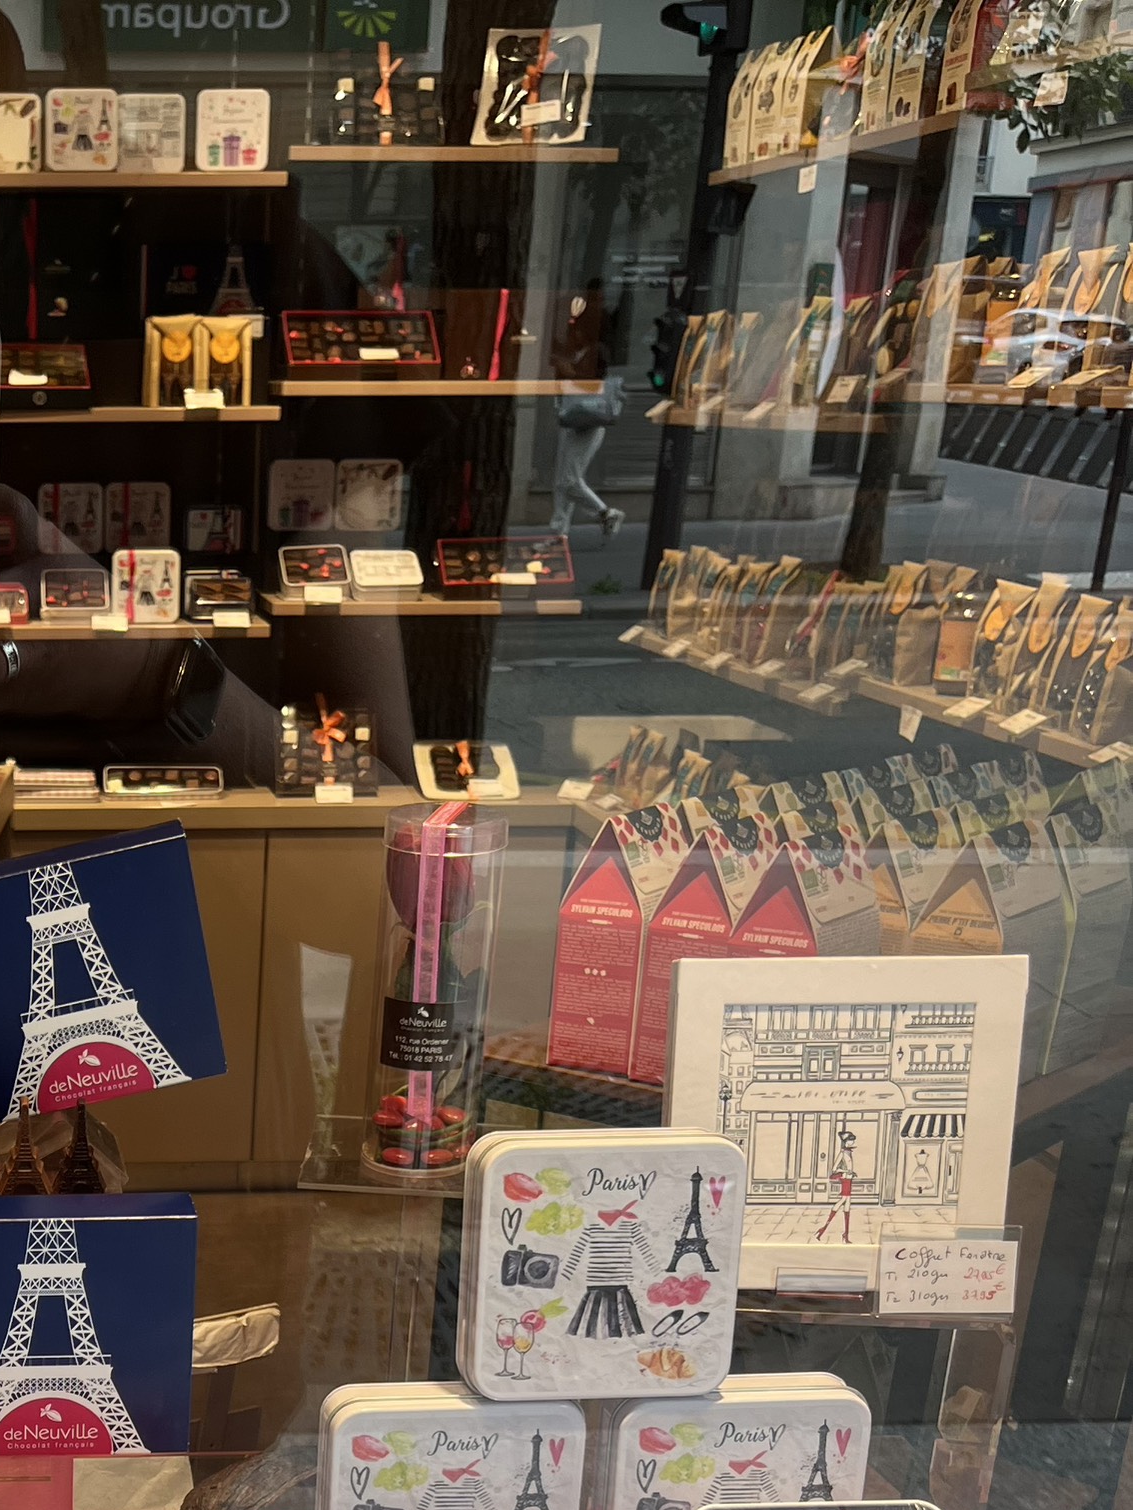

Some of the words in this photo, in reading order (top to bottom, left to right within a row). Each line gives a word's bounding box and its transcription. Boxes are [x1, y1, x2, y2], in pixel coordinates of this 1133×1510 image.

[48, 1062, 139, 1094] deNeuville
[54, 1089, 96, 1102] Chocolat
[99, 1080, 137, 1093] français
[581, 1167, 640, 1196] Paris
[3, 1423, 99, 1441] deNeuville
[54, 1441, 95, 1449] français
[427, 1430, 481, 1456] Paris
[714, 1421, 767, 1448] Paris
